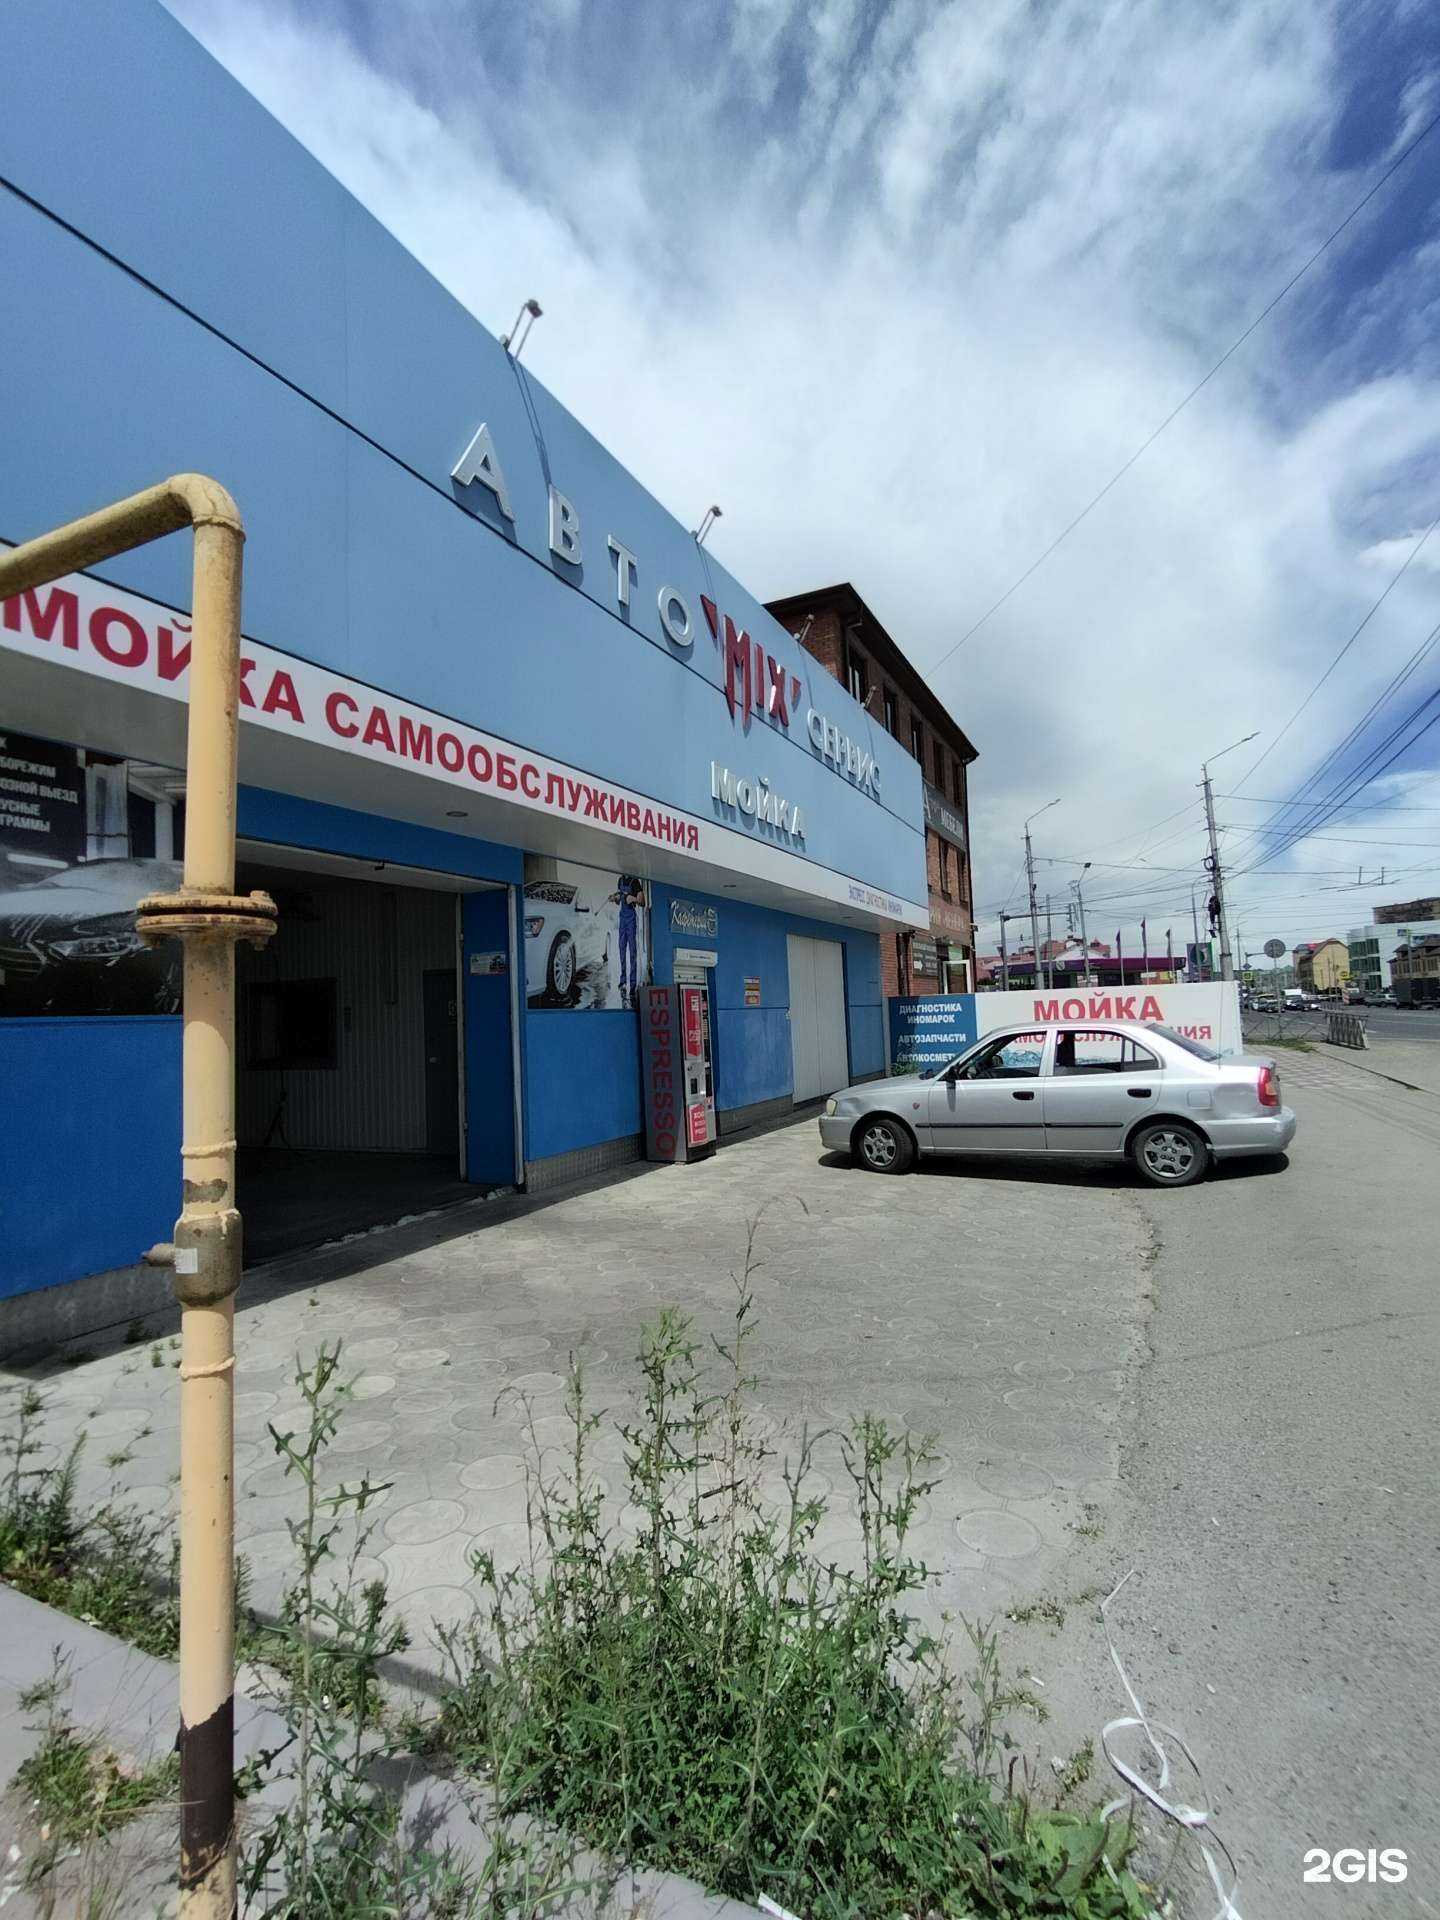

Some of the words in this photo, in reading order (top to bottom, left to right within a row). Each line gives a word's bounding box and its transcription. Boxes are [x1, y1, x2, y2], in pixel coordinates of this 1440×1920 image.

[450, 422, 696, 647] АВТО
[807, 708, 881, 792] СЕРВИС
[325, 692, 700, 851] САМООБСЛУЖИВАНИЯ
[711, 761, 807, 839] МОЙКА
[899, 1003, 962, 1014] ДИАГНОСТИКА
[907, 1014, 955, 1024] ИНОМАРОК
[1034, 992, 1164, 1021] МОЙКА
[898, 1033, 967, 1043] АВТОЗАПЧАСТИ
[649, 988, 676, 1157] ESPRESSO
